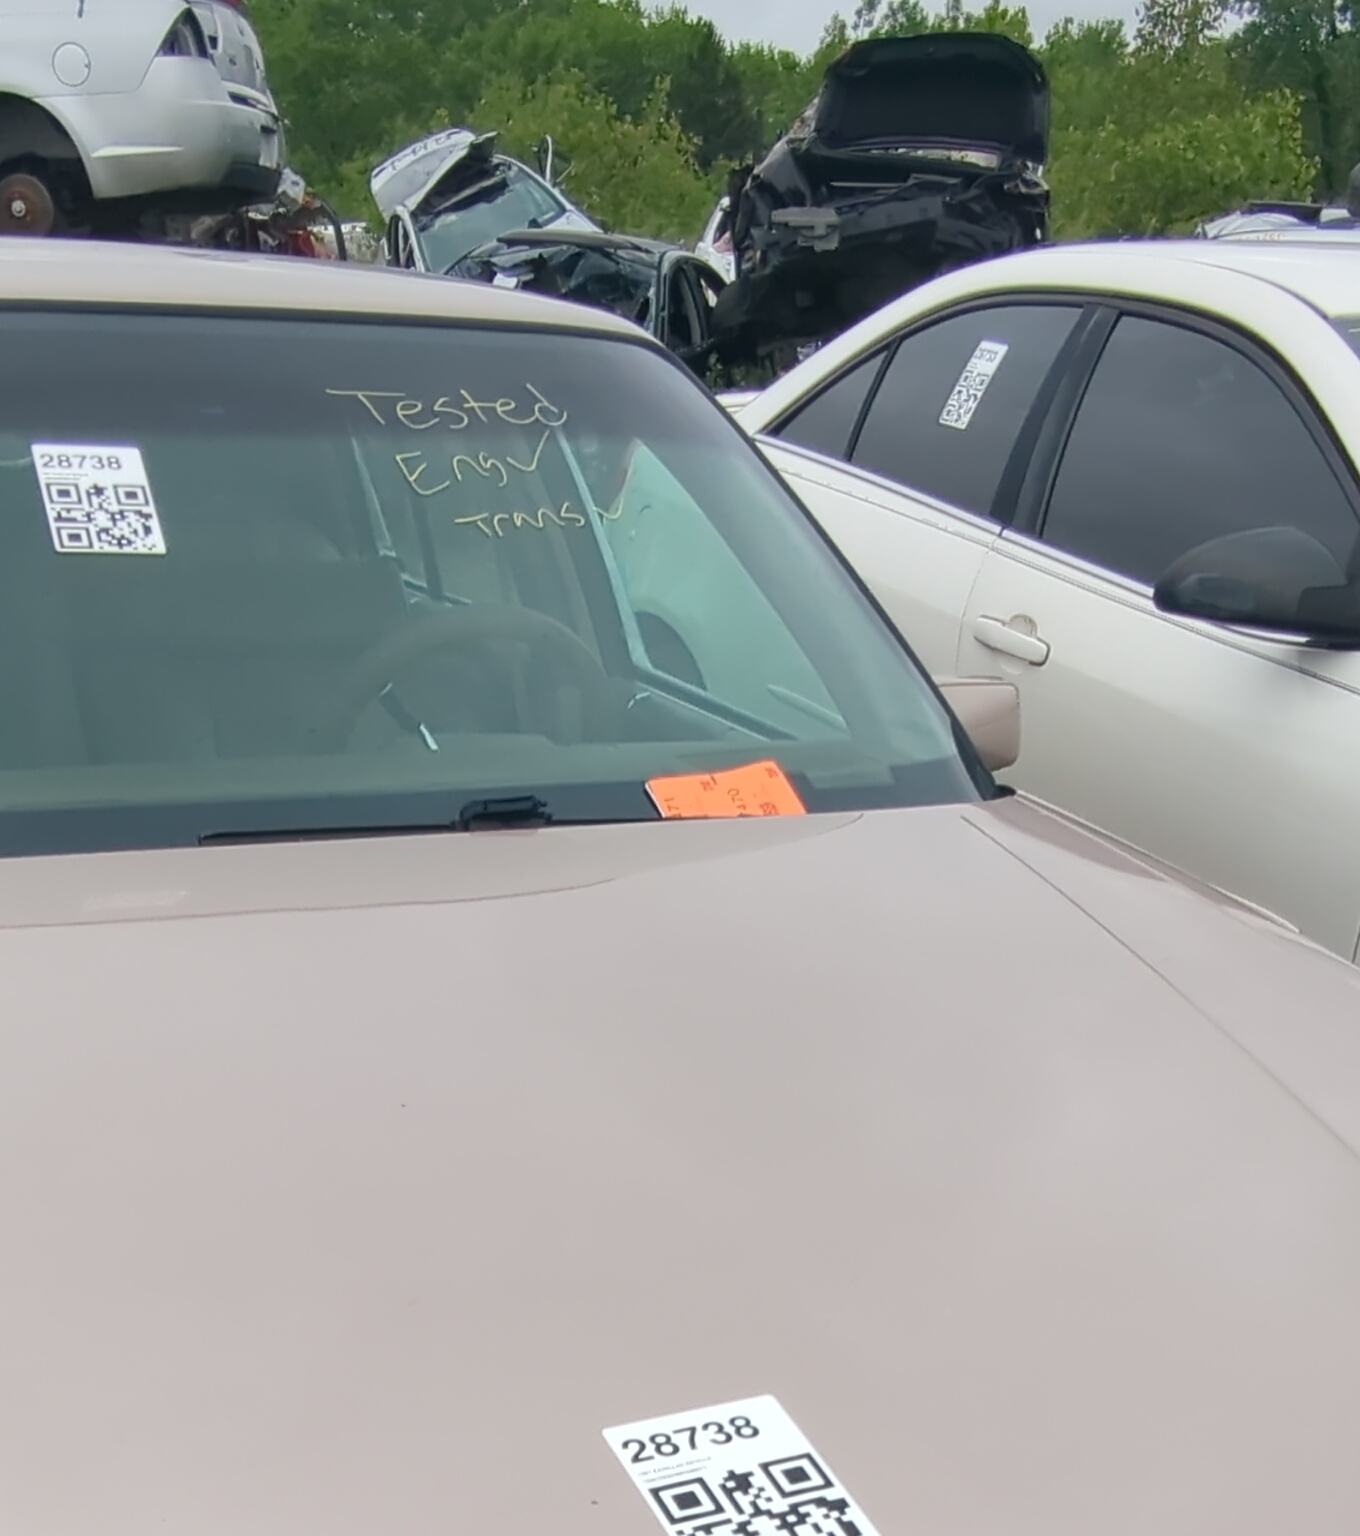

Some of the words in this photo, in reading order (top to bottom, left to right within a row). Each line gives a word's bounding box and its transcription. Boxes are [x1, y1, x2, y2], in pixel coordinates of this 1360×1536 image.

[325, 382, 568, 429] Tested
[40, 453, 122, 470] 28738
[454, 501, 586, 537] Trans
[621, 1415, 761, 1464] 28738
